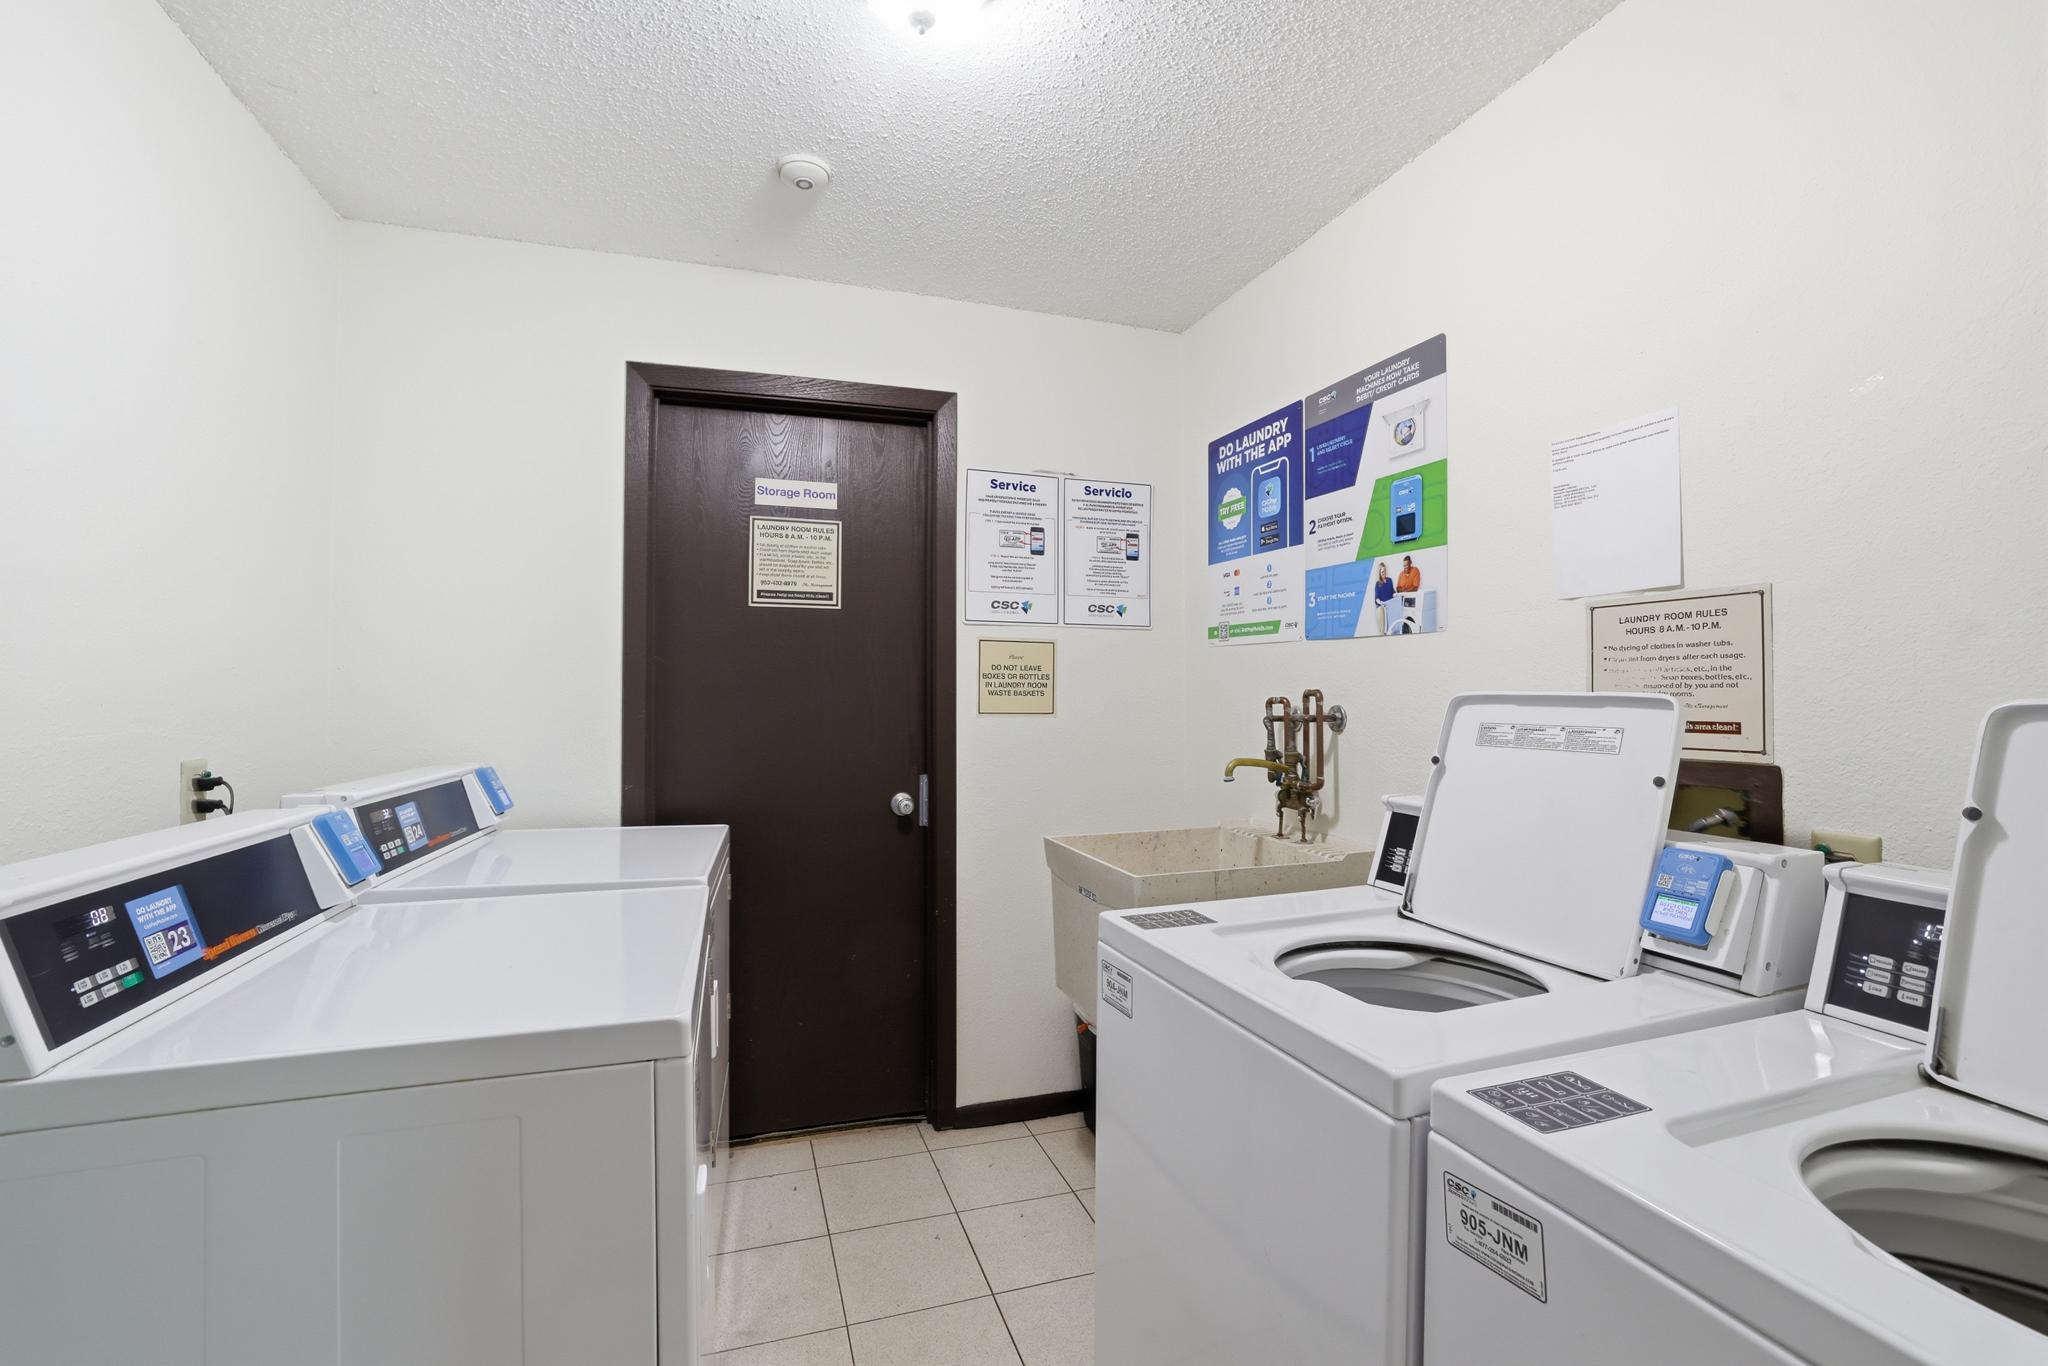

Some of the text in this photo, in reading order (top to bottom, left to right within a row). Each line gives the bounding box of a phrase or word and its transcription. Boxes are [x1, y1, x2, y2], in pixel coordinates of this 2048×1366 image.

[1356, 362, 1420, 394] MACHINES NOW TAKE
[1364, 357, 1410, 383] YOUR LAUNDRY
[1376, 380, 1397, 394] CREDIT
[1398, 370, 1420, 384] CARDS
[1219, 417, 1288, 459] DO LAUNDRY
[1217, 432, 1291, 474] WITH THE APP
[1309, 446, 1314, 462] 1
[757, 486, 836, 500] Storage Room
[990, 478, 1037, 493] Service
[1084, 486, 1132, 498] Servicio
[1220, 501, 1245, 516] TRY FREE
[1309, 520, 1316, 535] 2
[991, 600, 1019, 610] CSC
[1309, 592, 1315, 608] 3
[1088, 604, 1114, 613] CSC
[1619, 608, 1728, 624] LAUNDRY ROOM RULES
[1626, 626, 1655, 635] HOURS
[1659, 625, 1664, 633] 8
[1702, 622, 1721, 630] P.M.
[1650, 642, 1676, 650] clothes
[1658, 654, 1680, 662] dryers
[1720, 652, 1746, 660] usage.
[1695, 682, 1708, 690] you
[412, 825, 423, 839] 24
[136, 897, 172, 915] DO LAUNDRY
[138, 903, 177, 923] WITH THE APP
[167, 926, 191, 952] 23
[1447, 1178, 1469, 1195] CSC
[1460, 1209, 1528, 1262] 905-JNM
